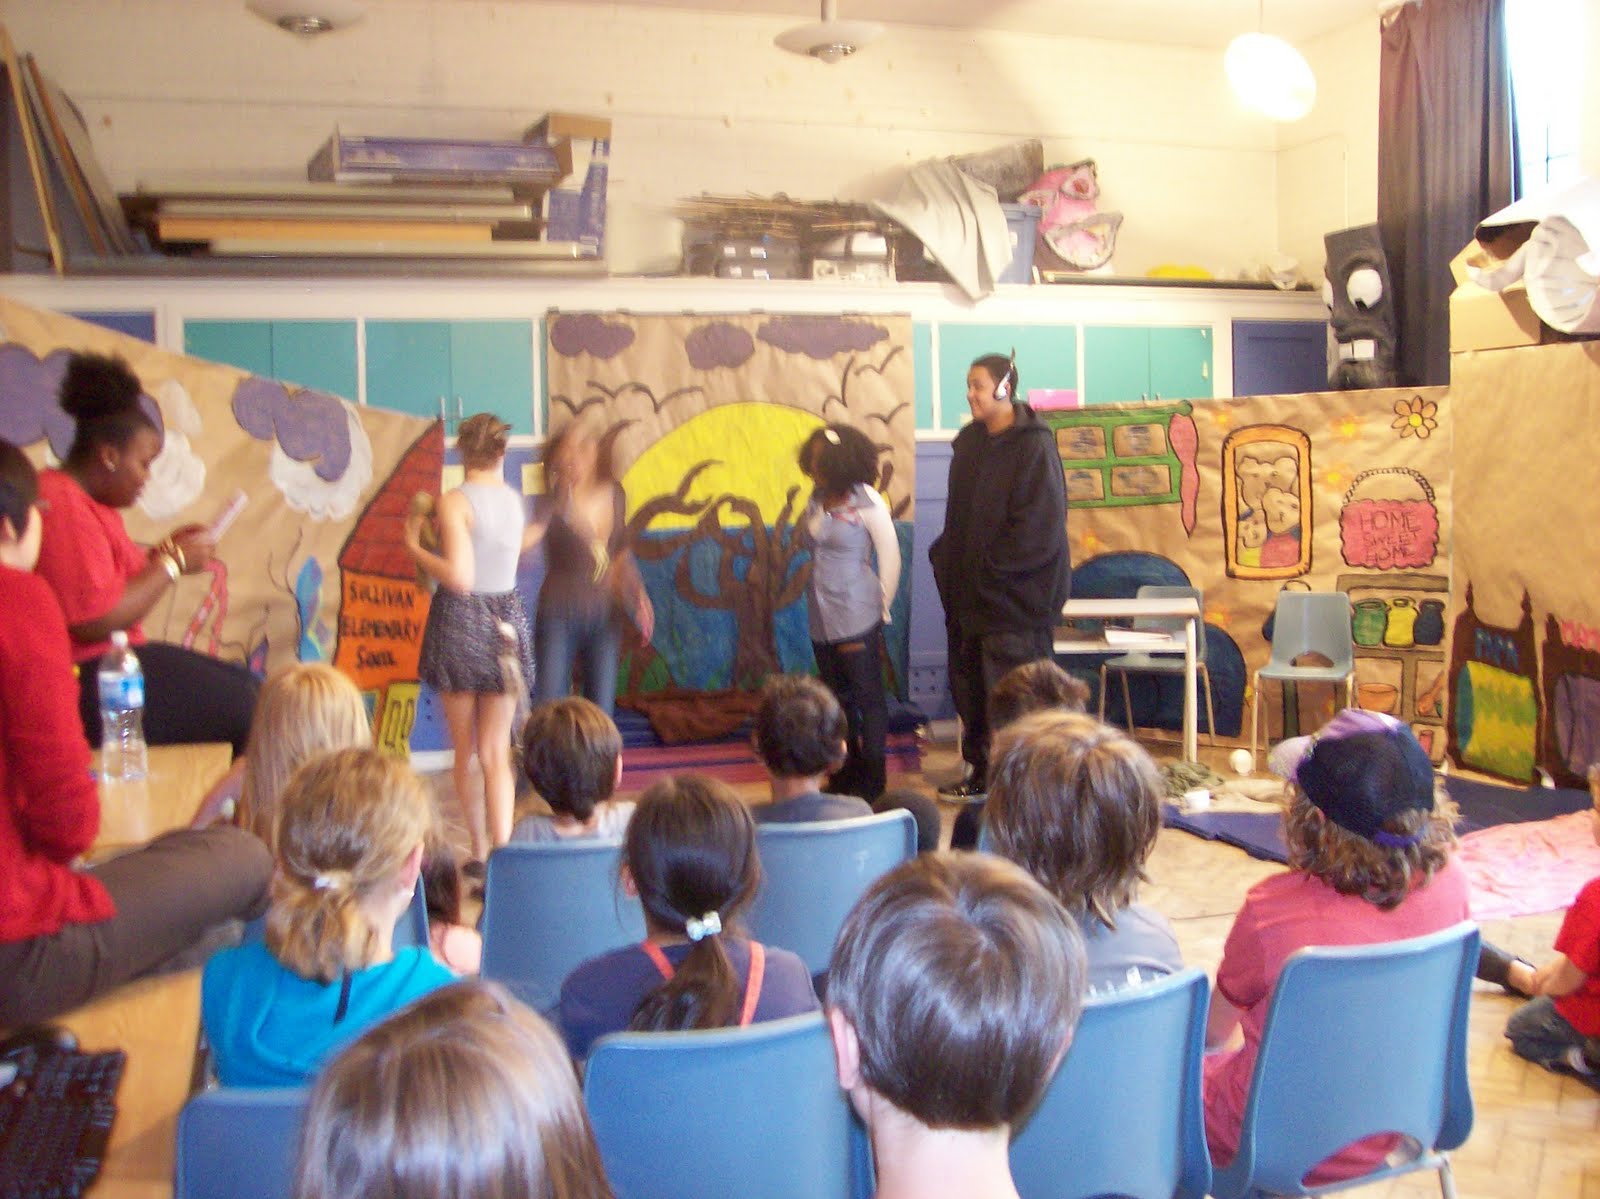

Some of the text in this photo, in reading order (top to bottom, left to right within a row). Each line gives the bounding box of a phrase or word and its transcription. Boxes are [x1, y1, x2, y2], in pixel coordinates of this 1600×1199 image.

[1360, 510, 1421, 532] HOME
[1363, 530, 1420, 548] SWEET
[1365, 545, 1415, 563] HOME
